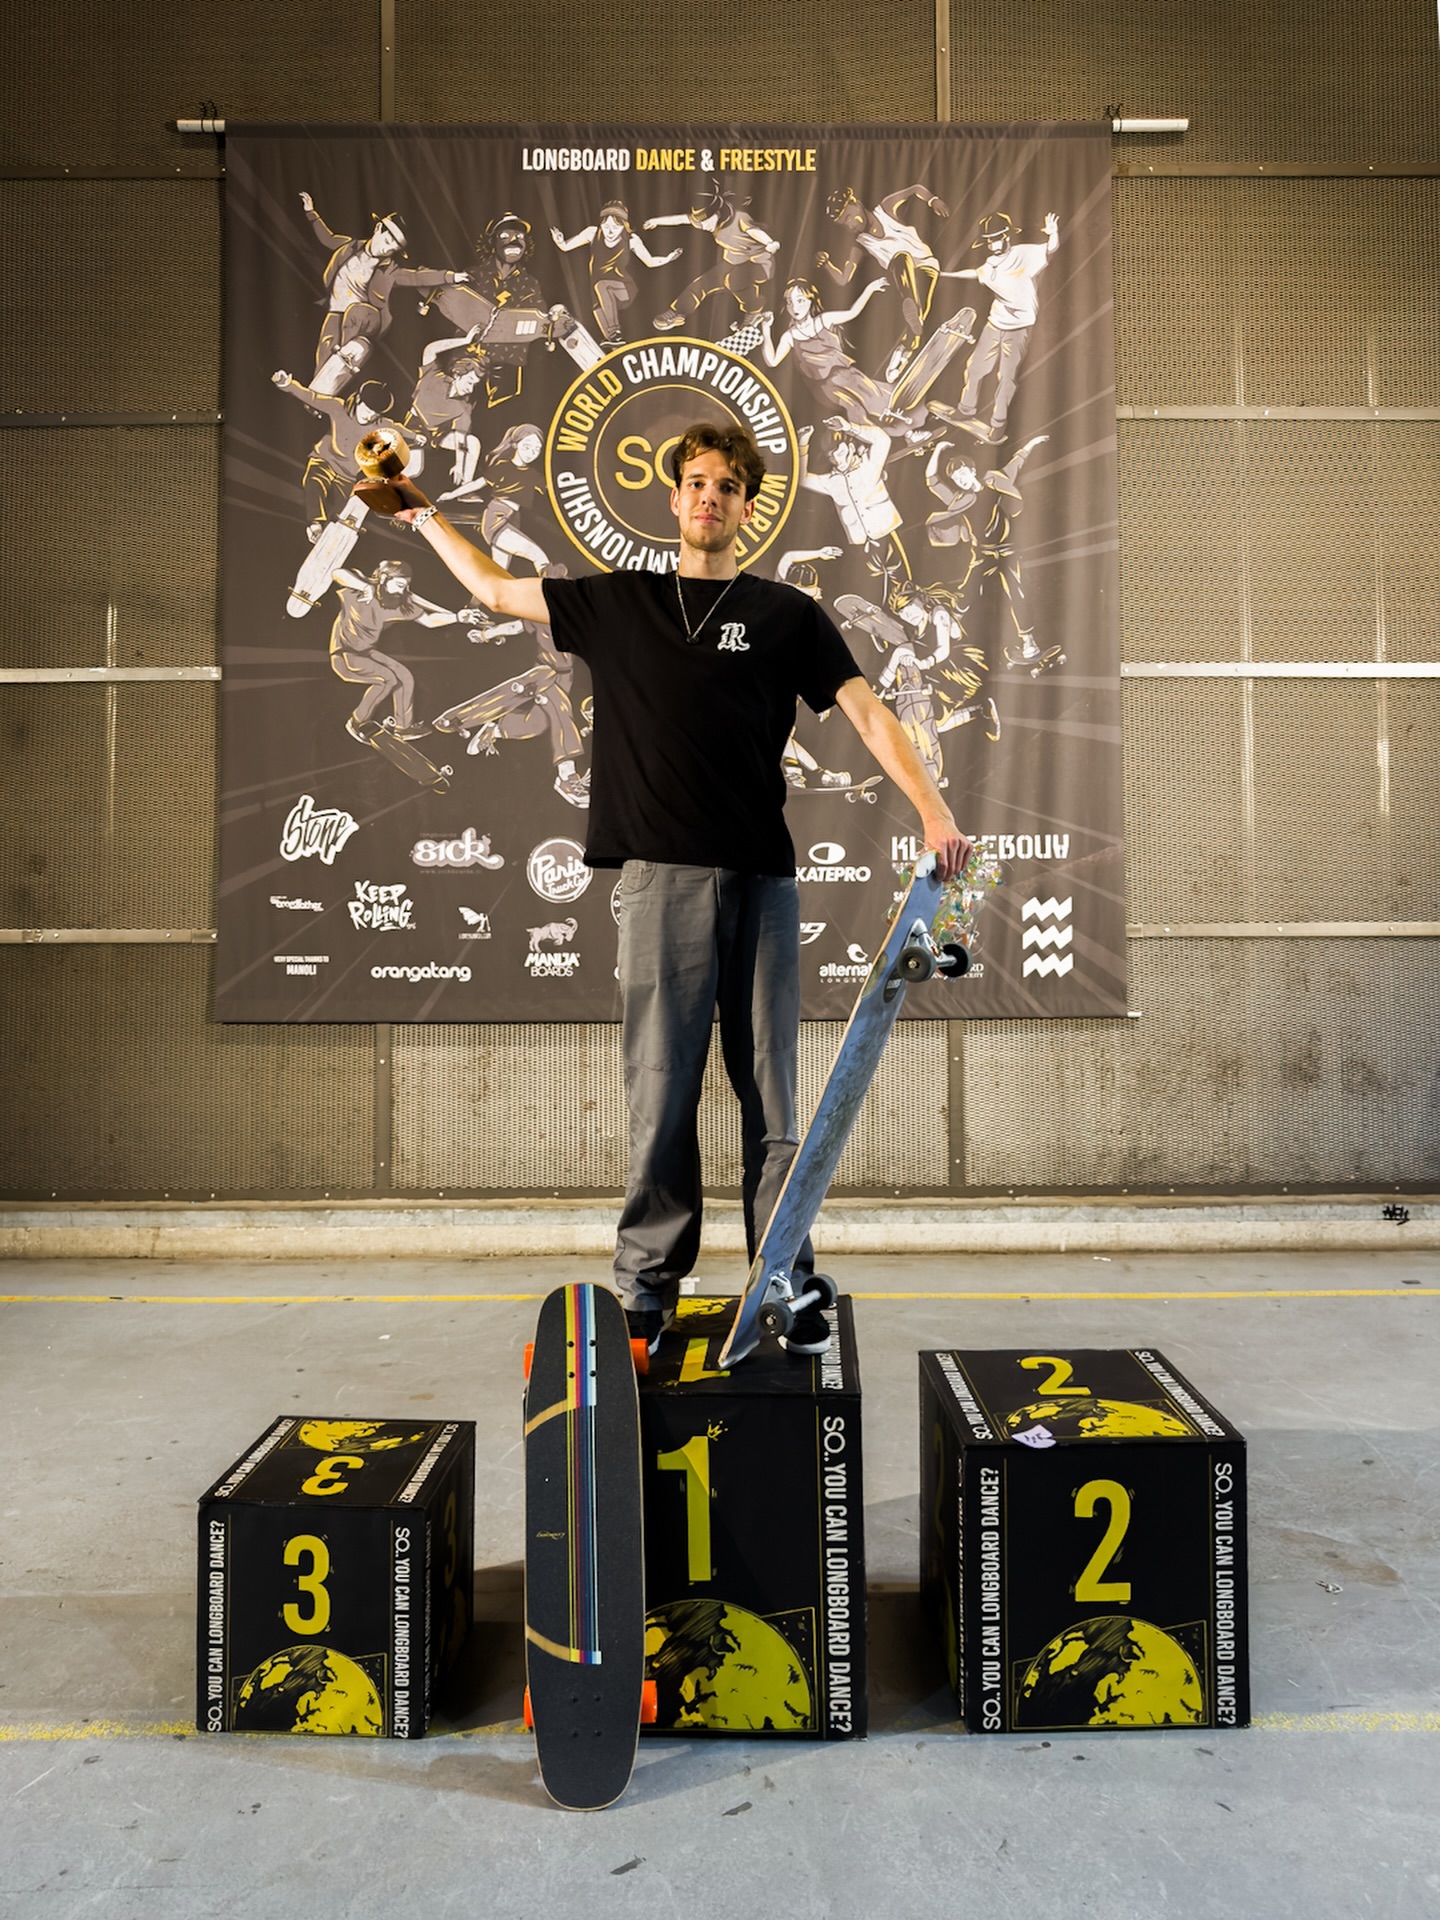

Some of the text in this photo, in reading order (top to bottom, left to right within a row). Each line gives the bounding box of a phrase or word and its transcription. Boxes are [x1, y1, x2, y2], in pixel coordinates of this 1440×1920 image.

[522, 148, 817, 172] LONGBOARD DANCE & FREESTYLE
[557, 346, 788, 455] WORLD CHAMPIONSHIP
[557, 471, 680, 575] MPIONSHIP
[891, 834, 1070, 861] KLEBOUW
[532, 854, 586, 891] Paris
[795, 866, 872, 882] KATEPRO
[354, 880, 407, 905] KEEP
[287, 965, 317, 975] MANOLI
[371, 961, 472, 982] orangatang
[531, 966, 574, 977] BOARDS
[1018, 1356, 1092, 1396] 2
[301, 1455, 365, 1497] 3
[824, 1463, 846, 1499] YOU
[656, 1435, 712, 1582] 1
[980, 1467, 999, 1526] DANCE?
[826, 1505, 848, 1541] CAN
[1215, 1501, 1233, 1530] YOU
[209, 1520, 225, 1568] DANCE?
[1073, 1478, 1132, 1602] 2
[1215, 1536, 1234, 1565] CAN
[282, 1534, 331, 1636] 3
[394, 1557, 410, 1582] YOU
[981, 1531, 1000, 1621] LONGBOARD
[208, 1572, 224, 1644] LONGBOARD
[394, 1586, 410, 1610] CAN
[827, 1547, 851, 1656] LONGBOARD
[1216, 1571, 1235, 1661] LONGBOARD
[394, 1613, 410, 1687] LONGBOARD
[982, 1626, 1000, 1656] CAN
[208, 1648, 223, 1672] CAN
[982, 1661, 1000, 1691] YOU
[208, 1676, 223, 1701] YOU
[829, 1662, 852, 1732] DANCE?
[1217, 1666, 1236, 1725] DANCE?
[393, 1691, 409, 1738] DANCE?
